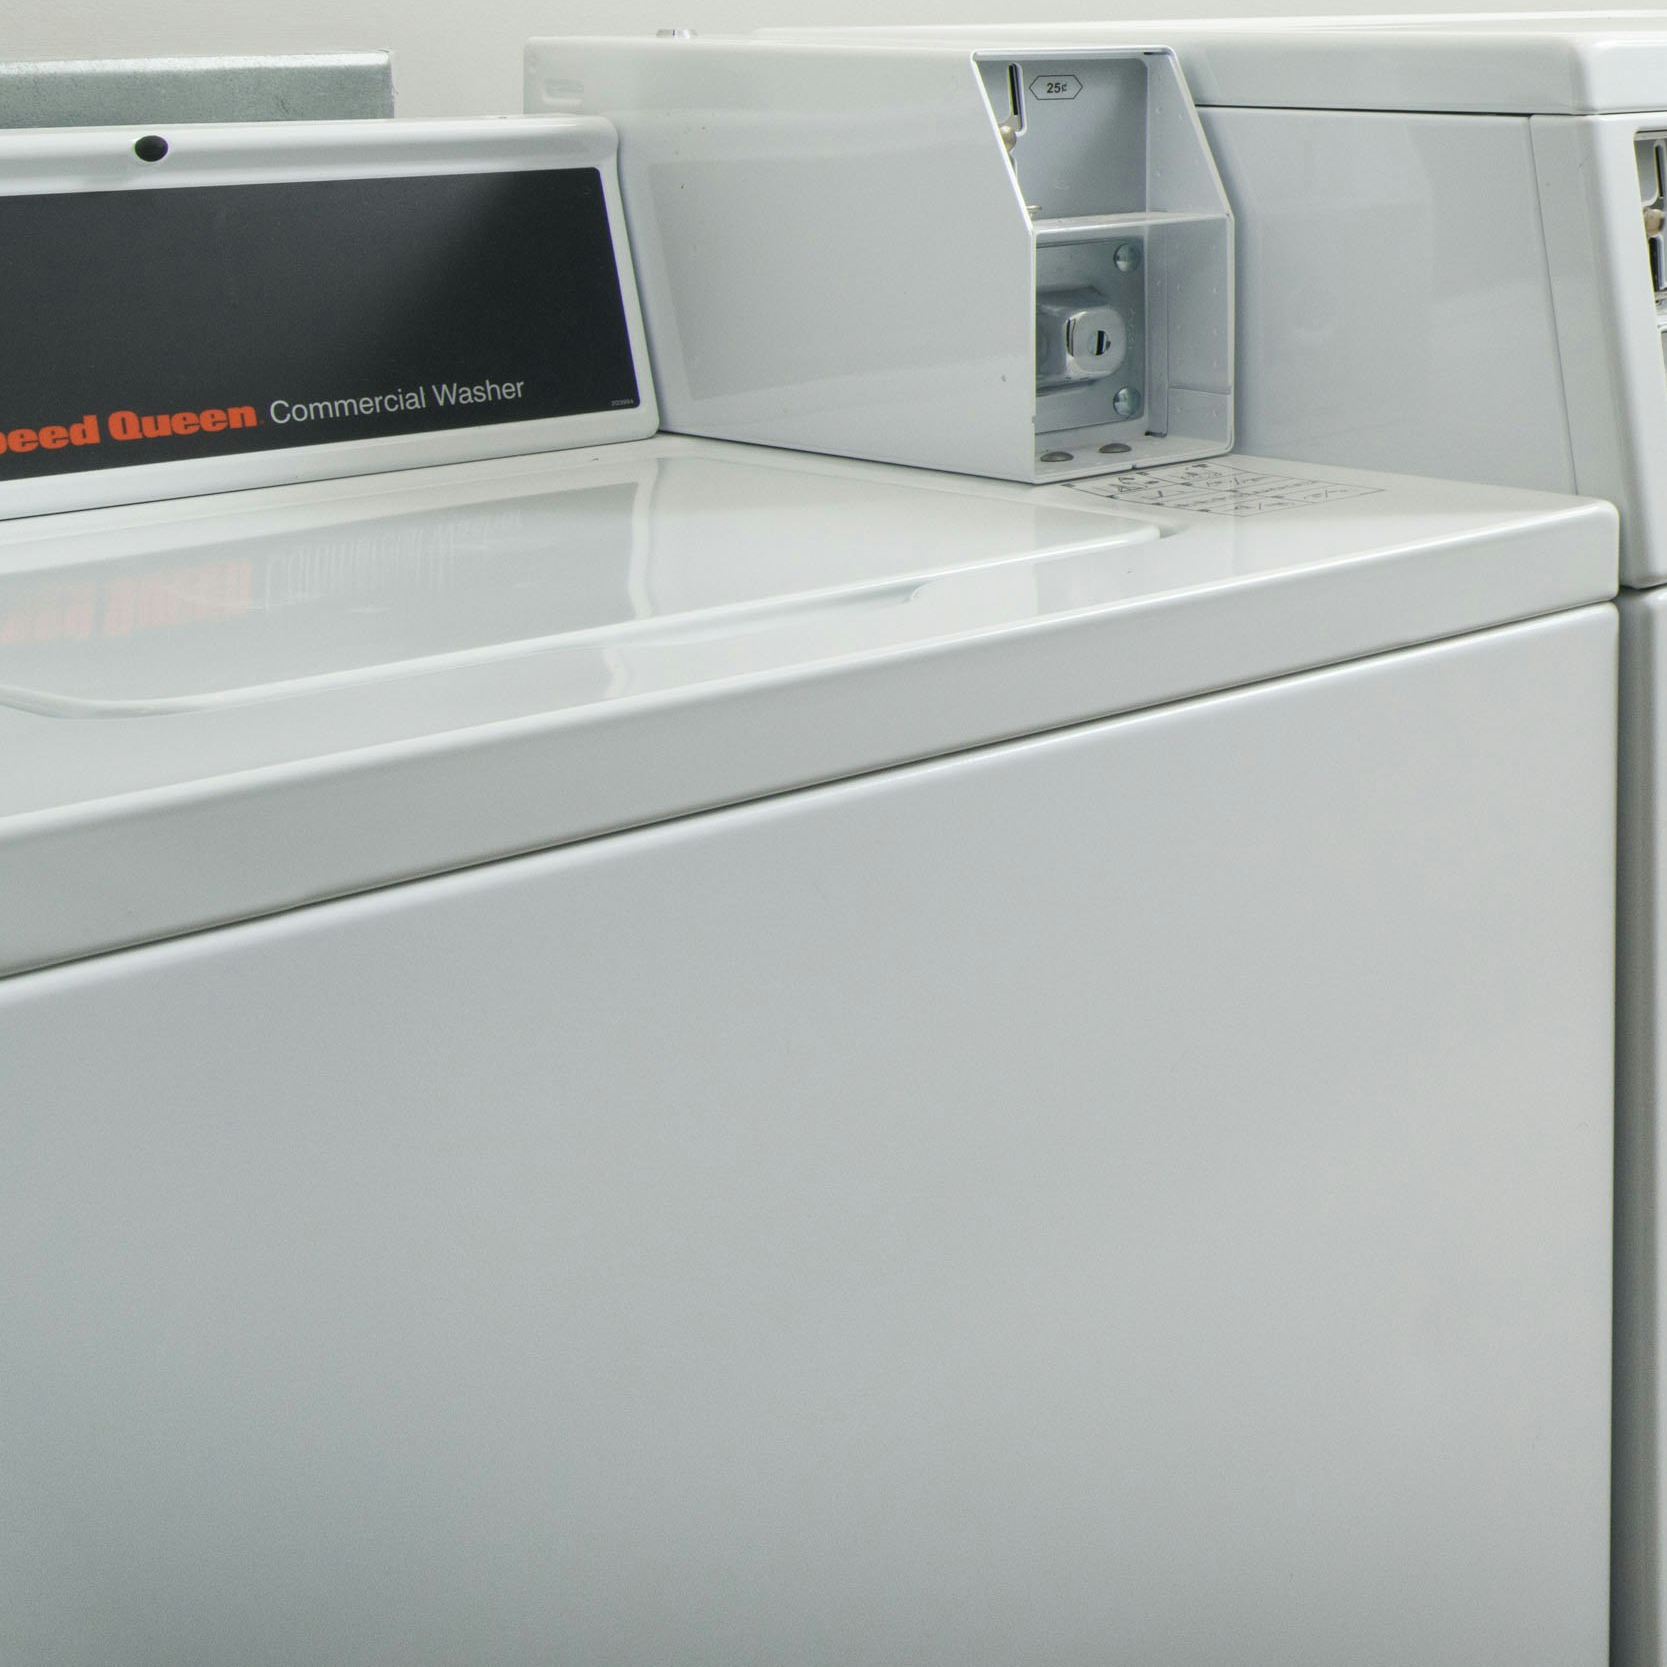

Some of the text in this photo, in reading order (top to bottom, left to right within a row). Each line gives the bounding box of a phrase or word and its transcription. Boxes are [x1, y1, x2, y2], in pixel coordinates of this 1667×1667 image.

[0, 379, 524, 455] eed Queen Commercial Washer
